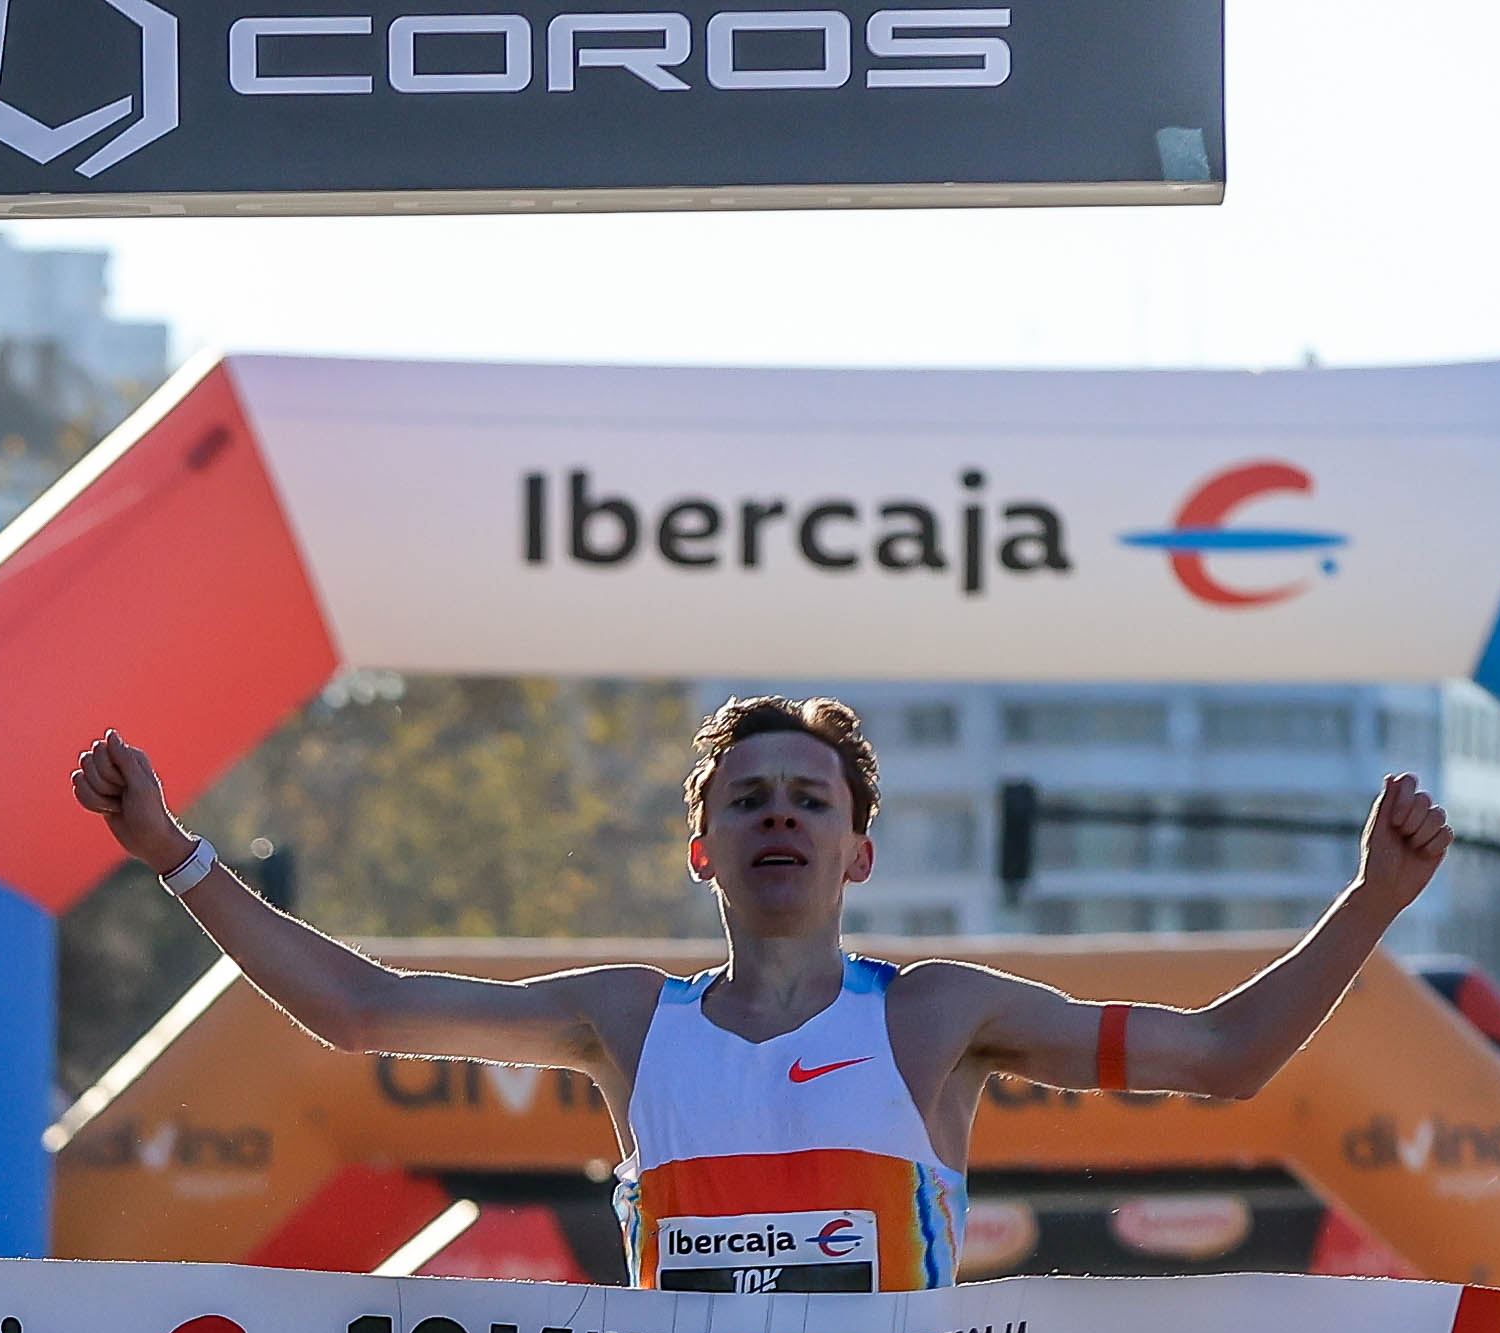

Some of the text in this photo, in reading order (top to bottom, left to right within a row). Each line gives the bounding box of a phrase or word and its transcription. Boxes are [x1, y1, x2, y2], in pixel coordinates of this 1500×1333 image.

[229, 7, 1011, 95] COROS
[522, 467, 1073, 596] Ibercaja
[668, 1224, 797, 1258] Ibercaja
[732, 1267, 784, 1294] 10K
